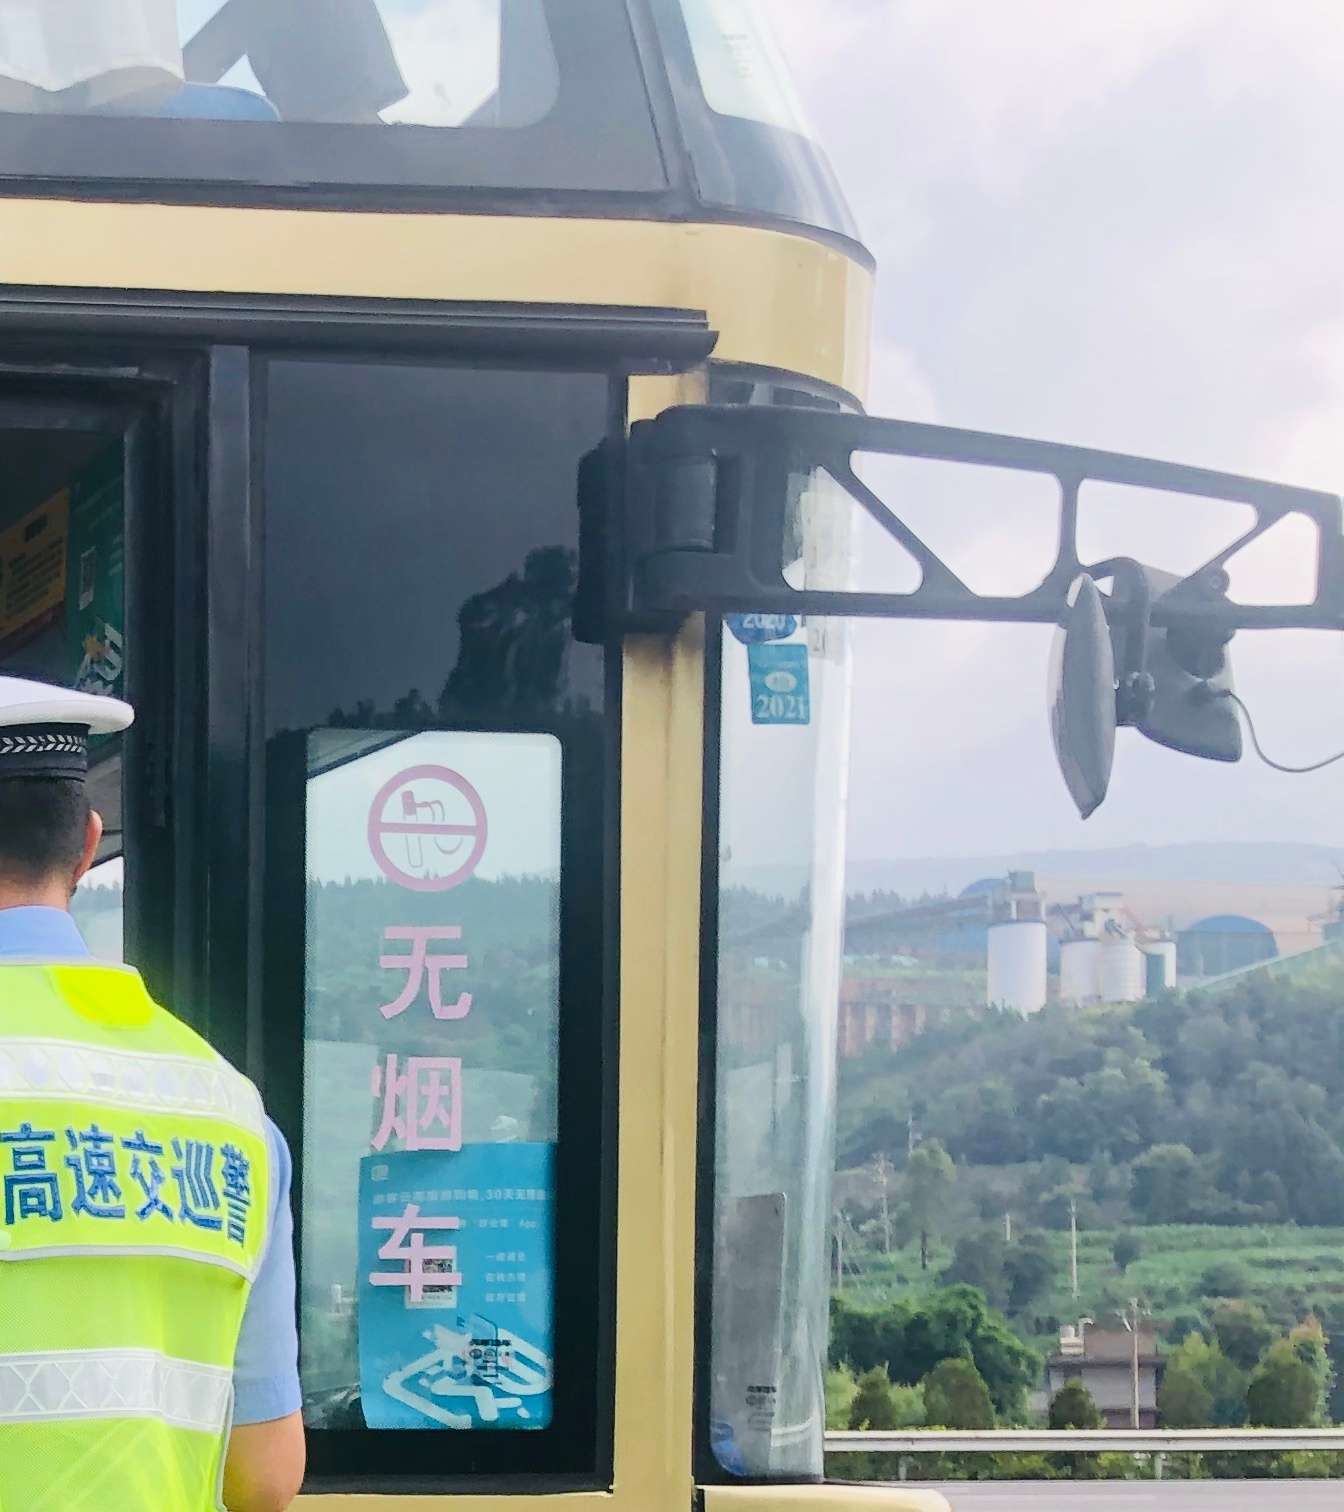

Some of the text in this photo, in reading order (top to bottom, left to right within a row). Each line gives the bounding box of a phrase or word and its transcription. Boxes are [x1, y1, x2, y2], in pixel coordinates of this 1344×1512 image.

[756, 695, 807, 719] 2021
[368, 925, 472, 1303] 无烟车
